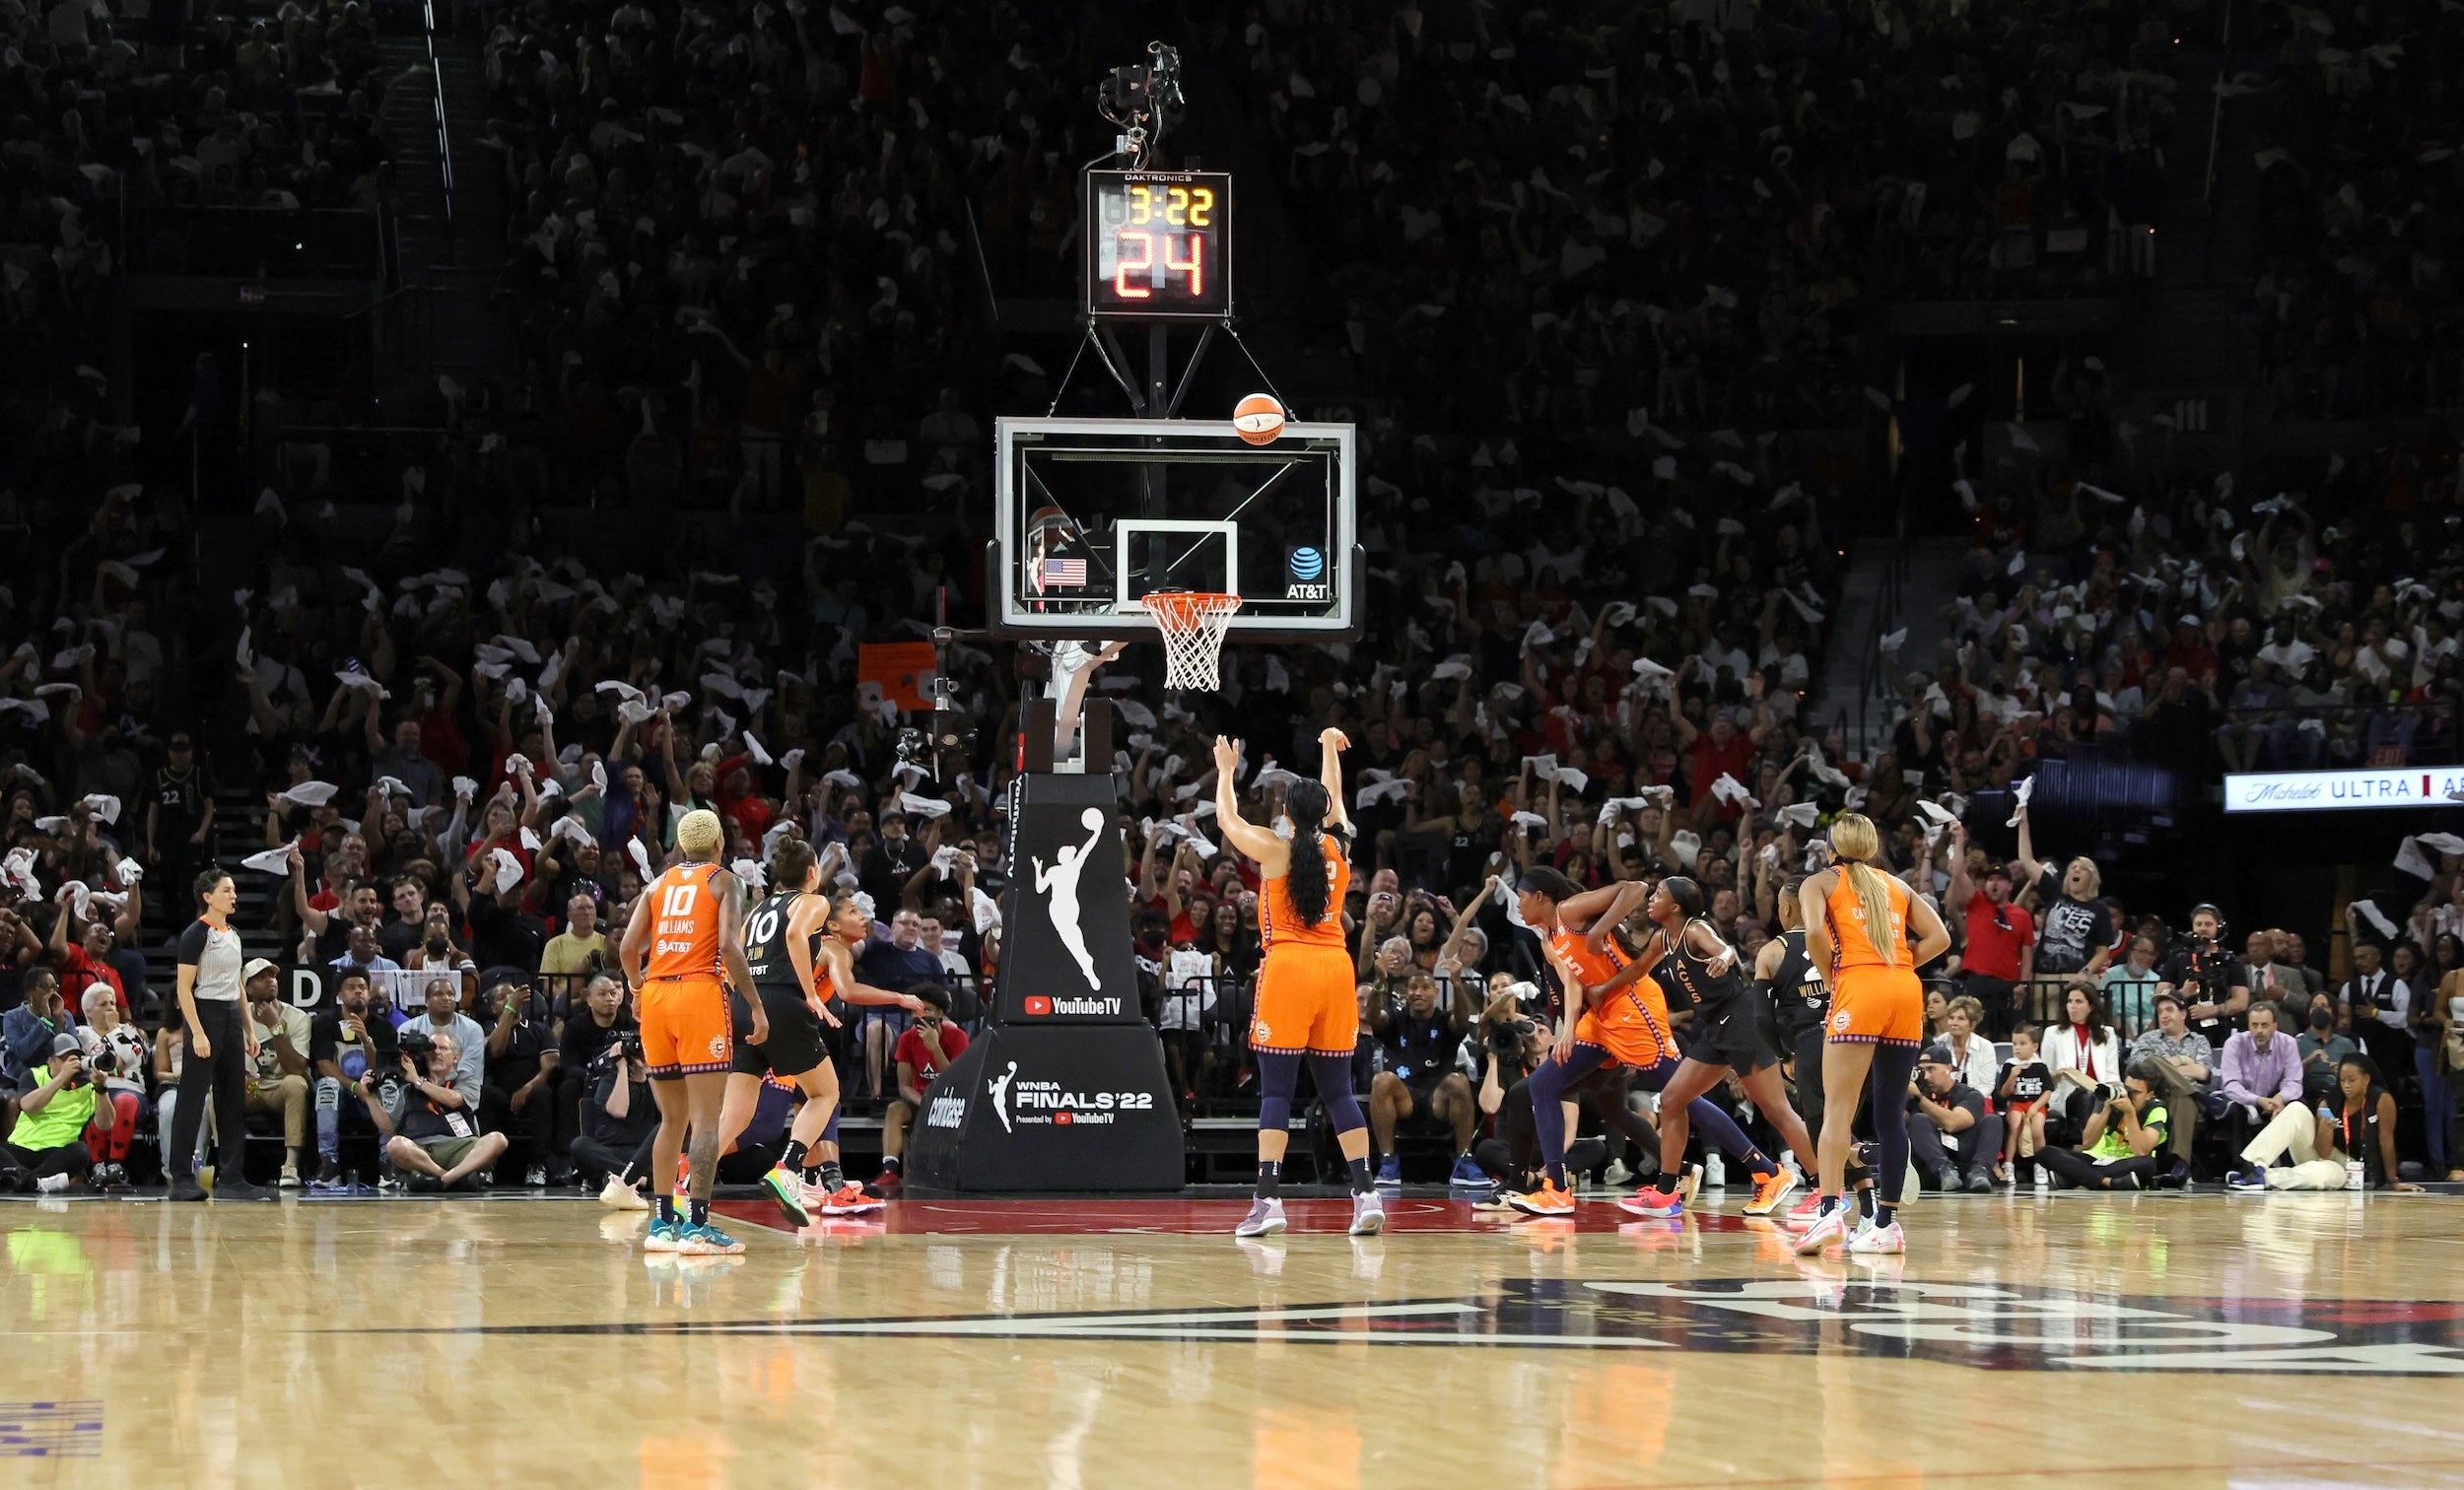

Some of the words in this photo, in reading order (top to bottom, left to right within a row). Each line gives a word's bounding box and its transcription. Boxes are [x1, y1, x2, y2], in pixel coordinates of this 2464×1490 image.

[1125, 173, 1192, 182] DAKTRONICS
[1130, 187, 1213, 227] 3:22
[1116, 231, 1201, 299] 24
[1286, 583, 1327, 599] AT&T
[162, 790, 180, 804] 22
[2246, 781, 2322, 803] Michelob
[2332, 779, 2410, 798] ULTRA
[1455, 837, 1469, 847] 22
[661, 885, 698, 917] 10
[657, 919, 695, 935] WILLIAMS
[747, 910, 779, 947] 10
[666, 941, 693, 954] AT&T
[747, 946, 765, 961] PLUM
[1677, 959, 1702, 1003] ACES
[1053, 996, 1122, 1015] YouTubeTV
[1016, 1081, 1061, 1091] WNBA
[2015, 1082, 2043, 1096] CES
[927, 1086, 966, 1129] coinbase
[1016, 1115, 1044, 1124] Presented
[1045, 1115, 1053, 1124] by
[1071, 1112, 1115, 1124] YouTubeTV
